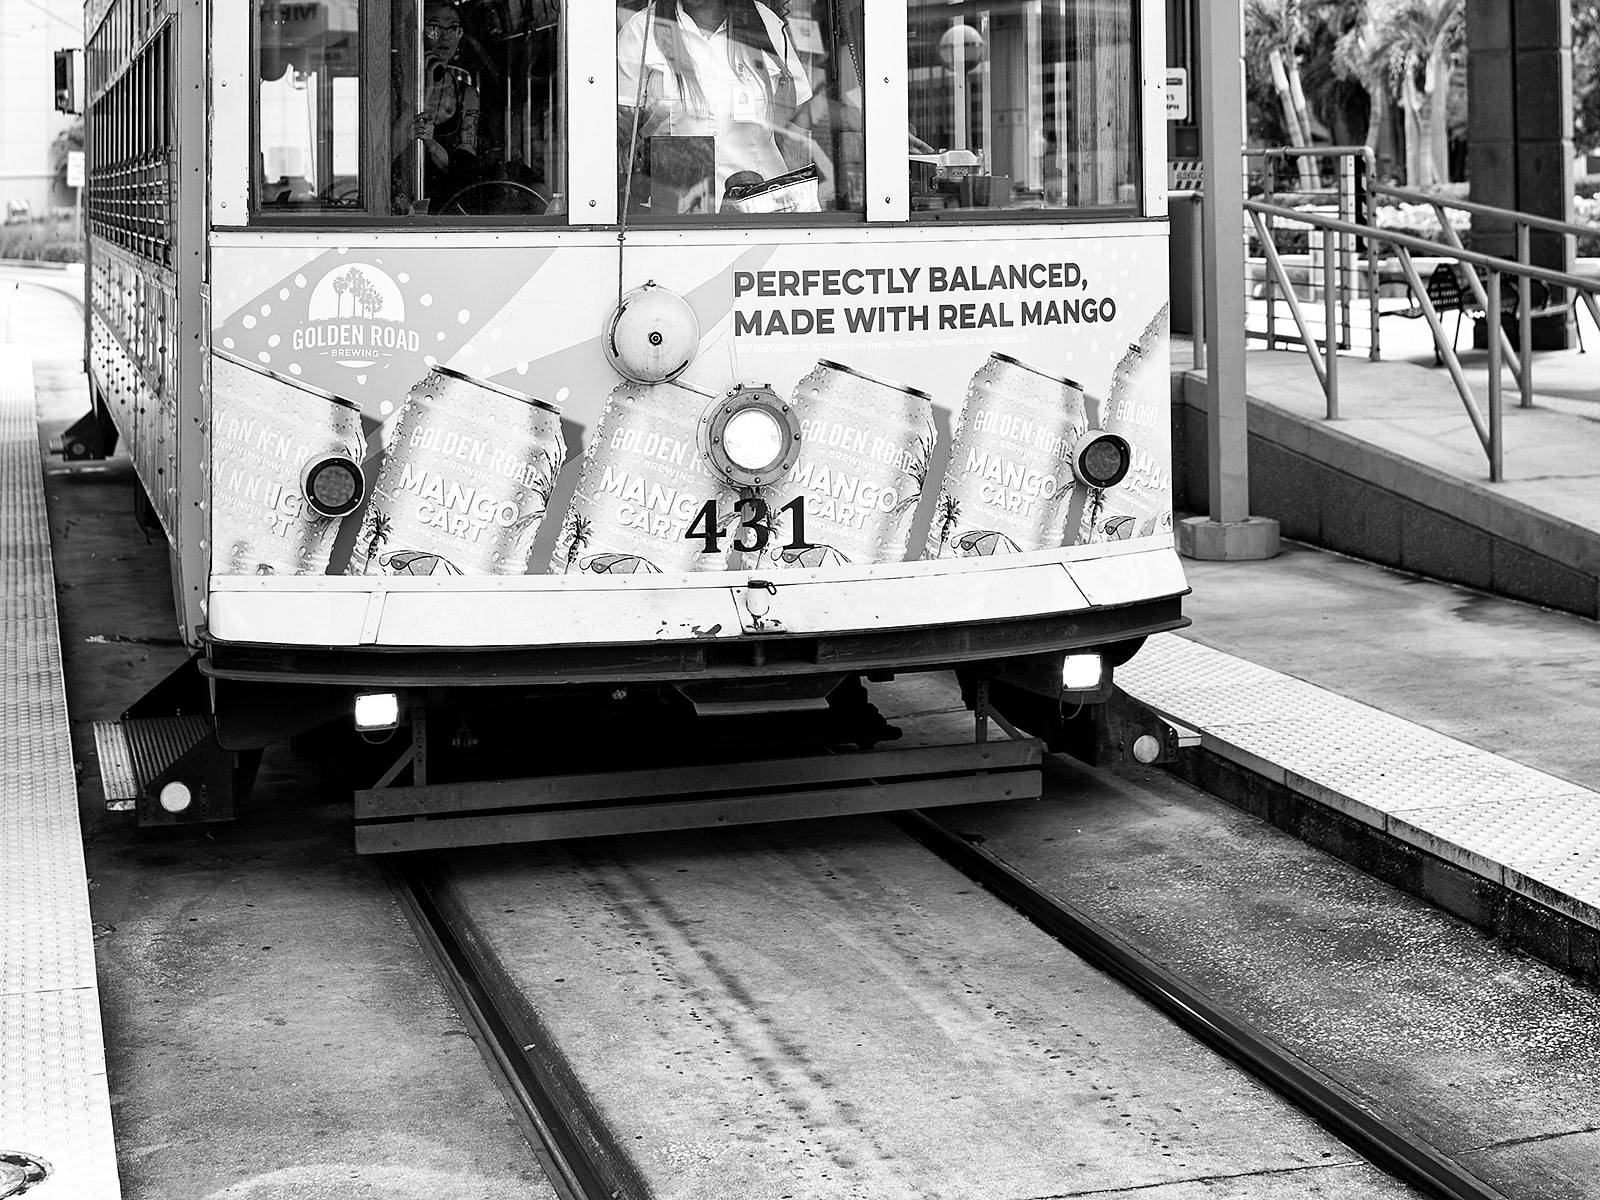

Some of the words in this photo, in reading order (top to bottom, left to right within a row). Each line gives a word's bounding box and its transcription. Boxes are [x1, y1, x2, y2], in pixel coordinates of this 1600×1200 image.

[734, 268, 921, 297] PERFECTLY
[928, 263, 1088, 293] BALANCED,
[735, 308, 835, 336] MADE
[844, 304, 929, 334] WITH
[938, 302, 1014, 330] REAL
[1021, 298, 1116, 326] MANGO
[293, 324, 364, 351] GOLDEN
[371, 325, 421, 352] ROAD
[331, 348, 379, 358] BREWING
[827, 341, 849, 351] Golden
[850, 341, 866, 350] Road
[894, 339, 916, 350] Mango
[932, 337, 956, 346] Flavored
[957, 336, 975, 345] Wheat
[987, 335, 997, 344] Los
[1020, 334, 1029, 343] CA
[610, 427, 691, 466] GOLDEN
[800, 418, 871, 455] GOLDEN
[870, 436, 915, 474] ROAD
[973, 409, 1035, 444] GOLDEN
[1034, 426, 1070, 461] ROAD
[999, 439, 1039, 460] BREWING
[409, 425, 488, 466] GOLDEN
[489, 448, 539, 489] ROAD
[442, 459, 496, 484] BREWING
[643, 461, 695, 484] BREWING
[828, 449, 876, 471] BREWING
[965, 446, 1058, 500] MANGO
[398, 463, 519, 528] MANGO
[599, 466, 698, 522] MANG
[787, 458, 899, 513] MANGO
[979, 482, 1036, 517] CART
[414, 501, 488, 543] CART
[616, 503, 690, 543] CART
[685, 495, 815, 554] 431
[804, 493, 872, 530] CART
